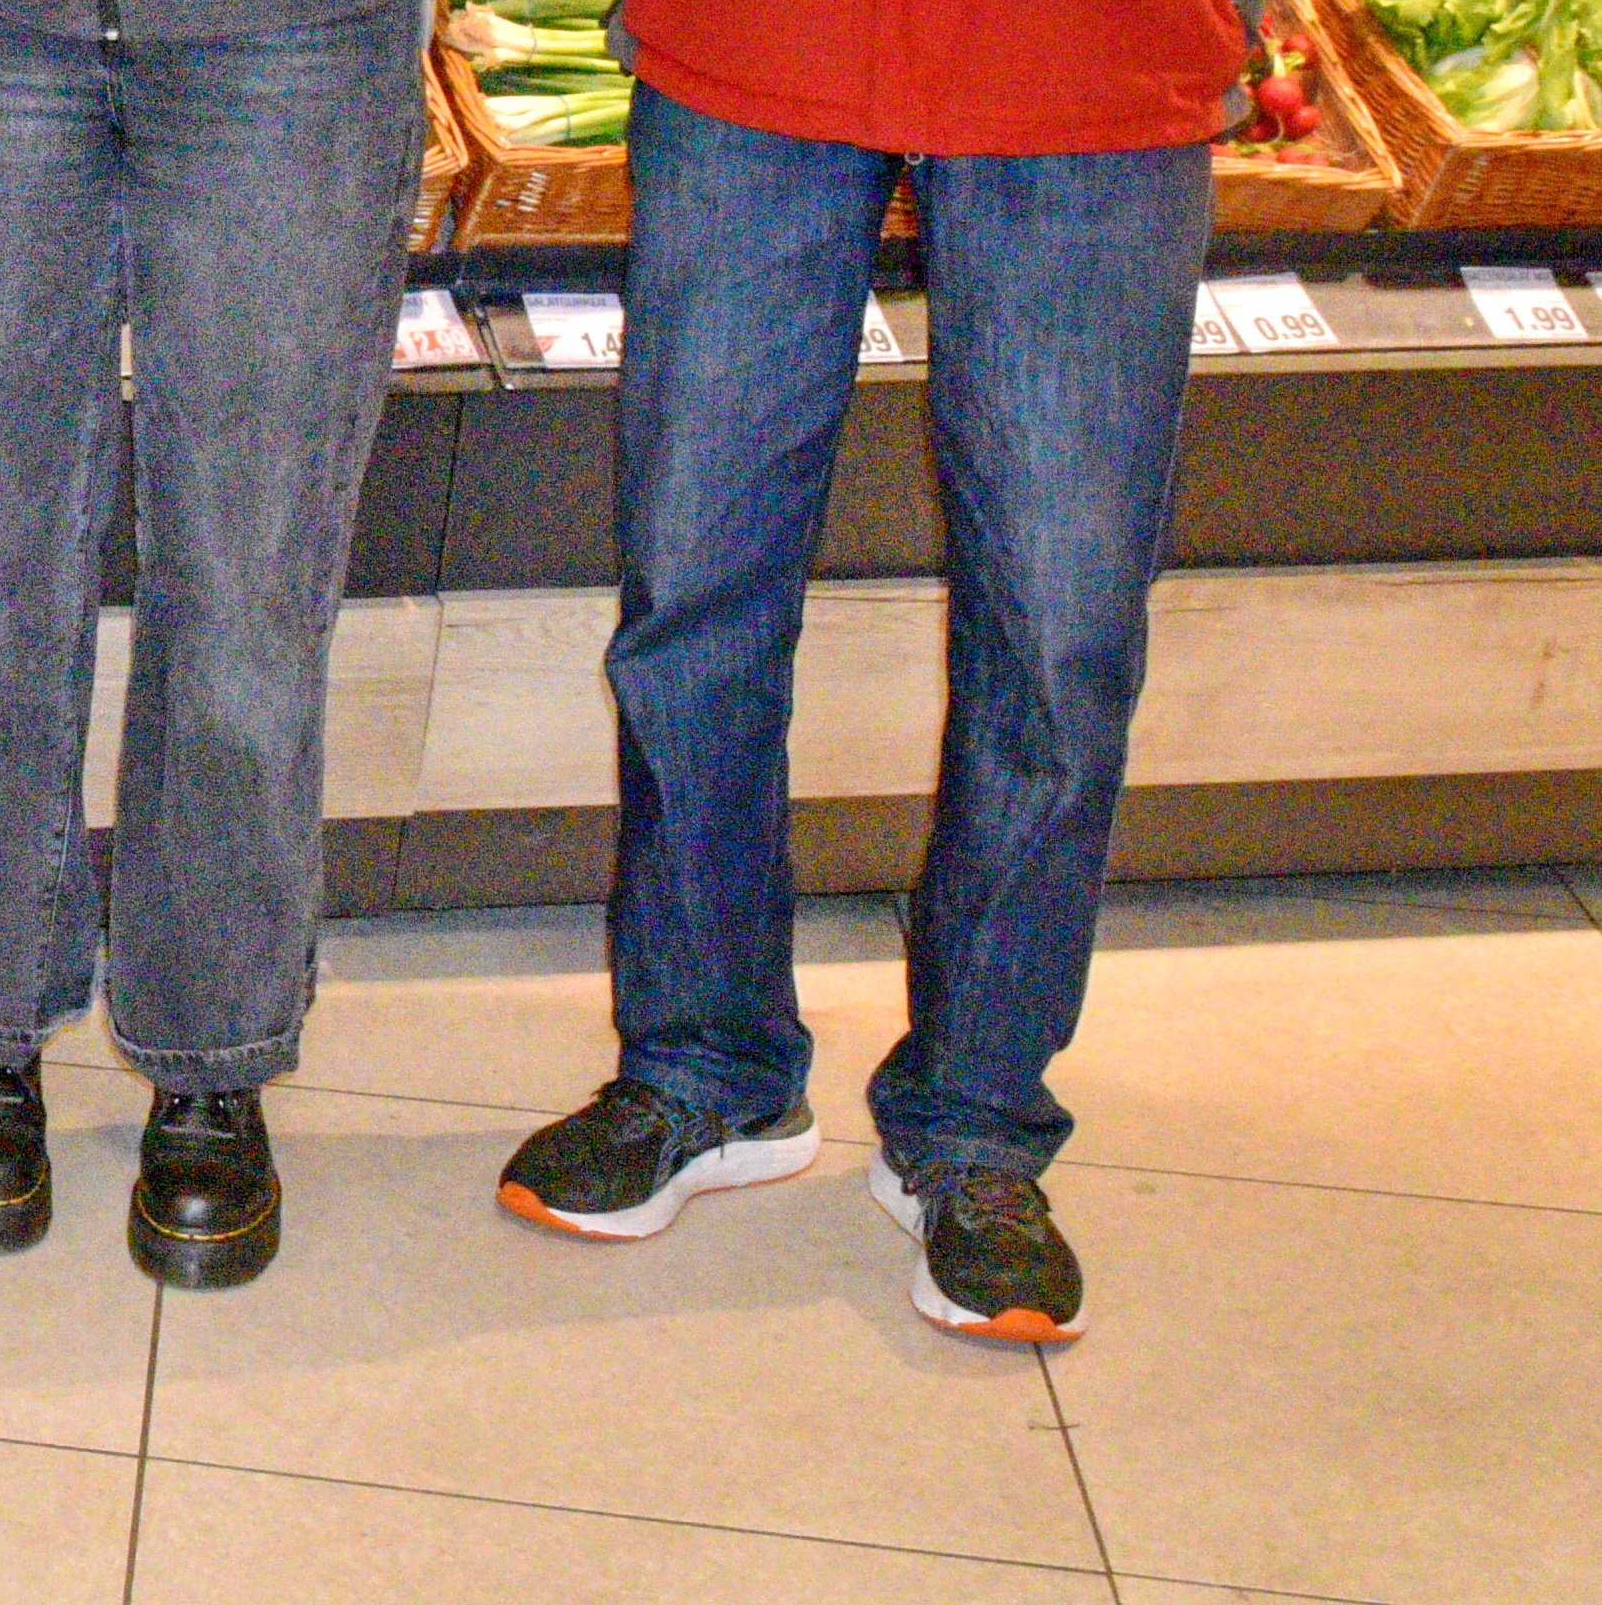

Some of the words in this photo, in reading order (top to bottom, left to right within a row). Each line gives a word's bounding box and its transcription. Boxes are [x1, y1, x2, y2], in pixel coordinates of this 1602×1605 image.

[1252, 312, 1327, 342] 0.99
[1504, 306, 1576, 331] 1.99
[413, 328, 473, 356] 2.99
[581, 331, 623, 357] 1.4
